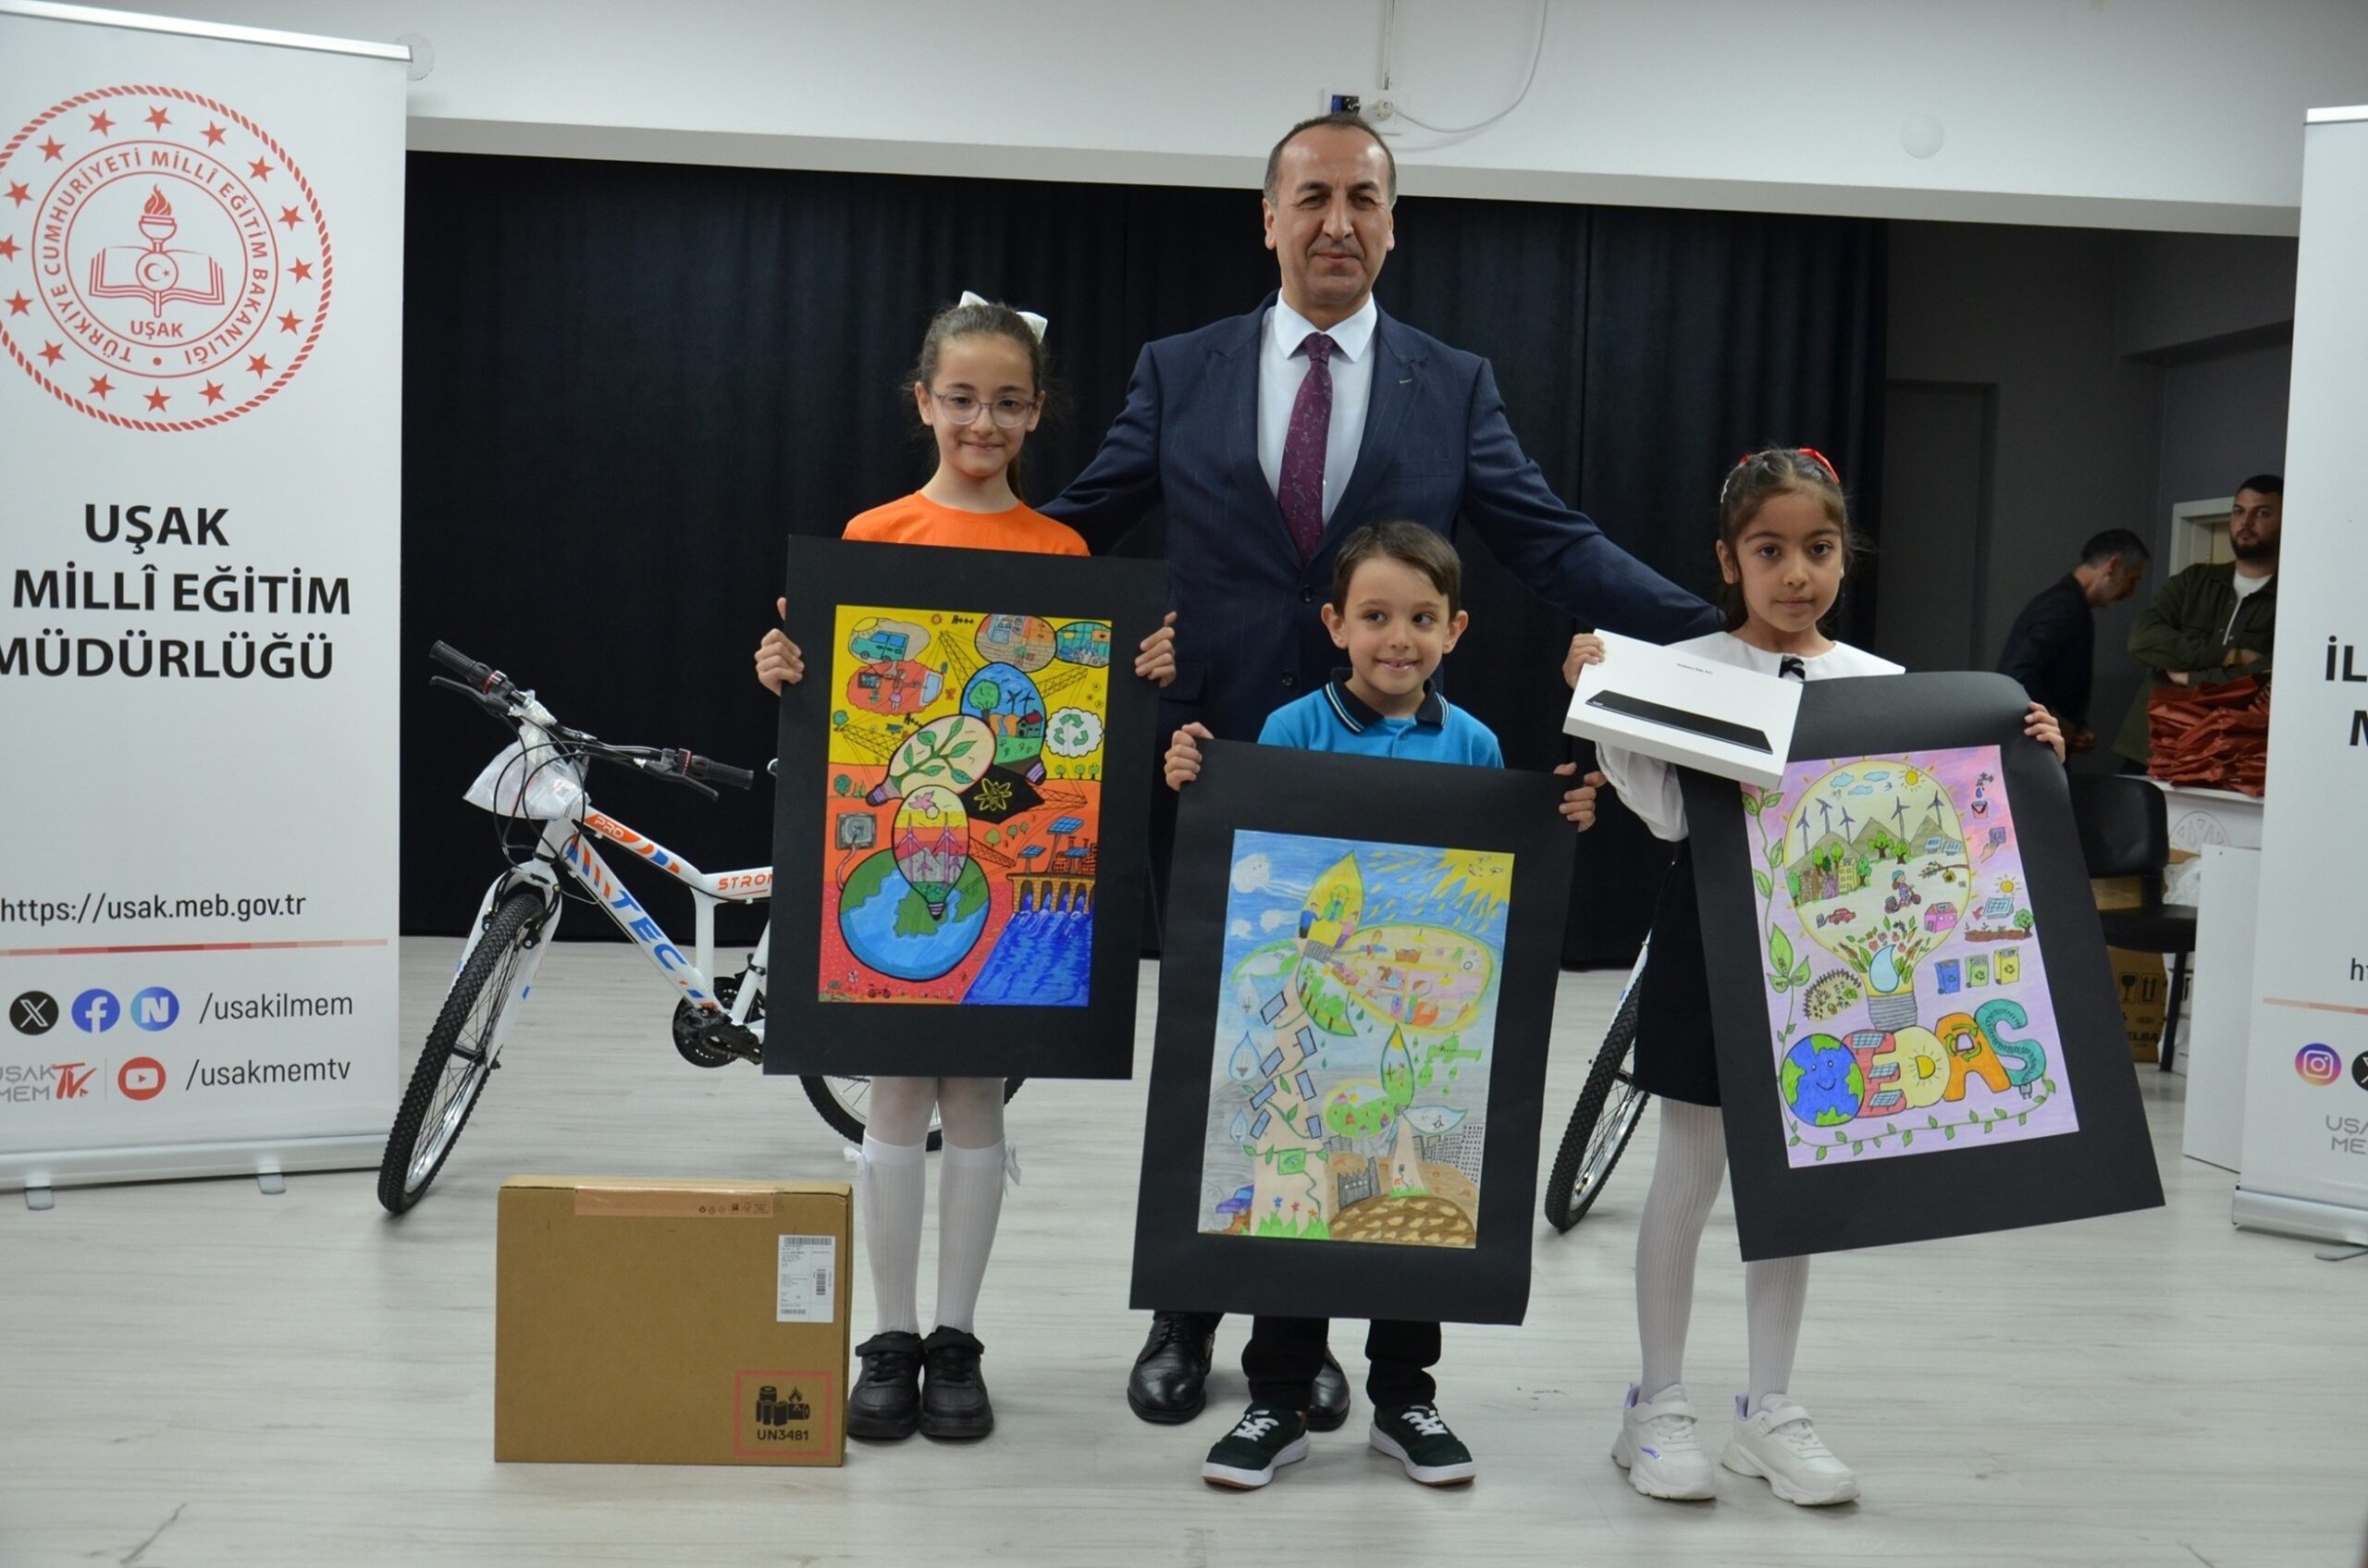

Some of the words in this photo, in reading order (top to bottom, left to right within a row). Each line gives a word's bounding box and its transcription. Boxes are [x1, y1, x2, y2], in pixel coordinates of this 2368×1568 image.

[151, 149, 218, 185] MİLLÎ
[43, 147, 142, 276] CUMHURİYETİ
[218, 181, 269, 259] EĞİTİM
[50, 283, 132, 364] TÜRKİYE
[130, 319, 184, 340] UŞAK
[184, 267, 270, 366] BAKANLIĞI
[85, 503, 230, 555] UŞAK
[13, 561, 159, 611] MİLLÎ
[173, 564, 351, 615] EĞİTİM
[0, 627, 333, 680] MÜDÜRLÜĞÜ
[2325, 636, 2368, 683] İL
[594, 815, 625, 839] PRO
[1, 893, 306, 927] https://usak.meb.gov.tr
[610, 889, 688, 972] TEC
[199, 993, 353, 1025] /usakilmem
[185, 1058, 352, 1091] /usakmemtv
[756, 1429, 809, 1441] UN3481
